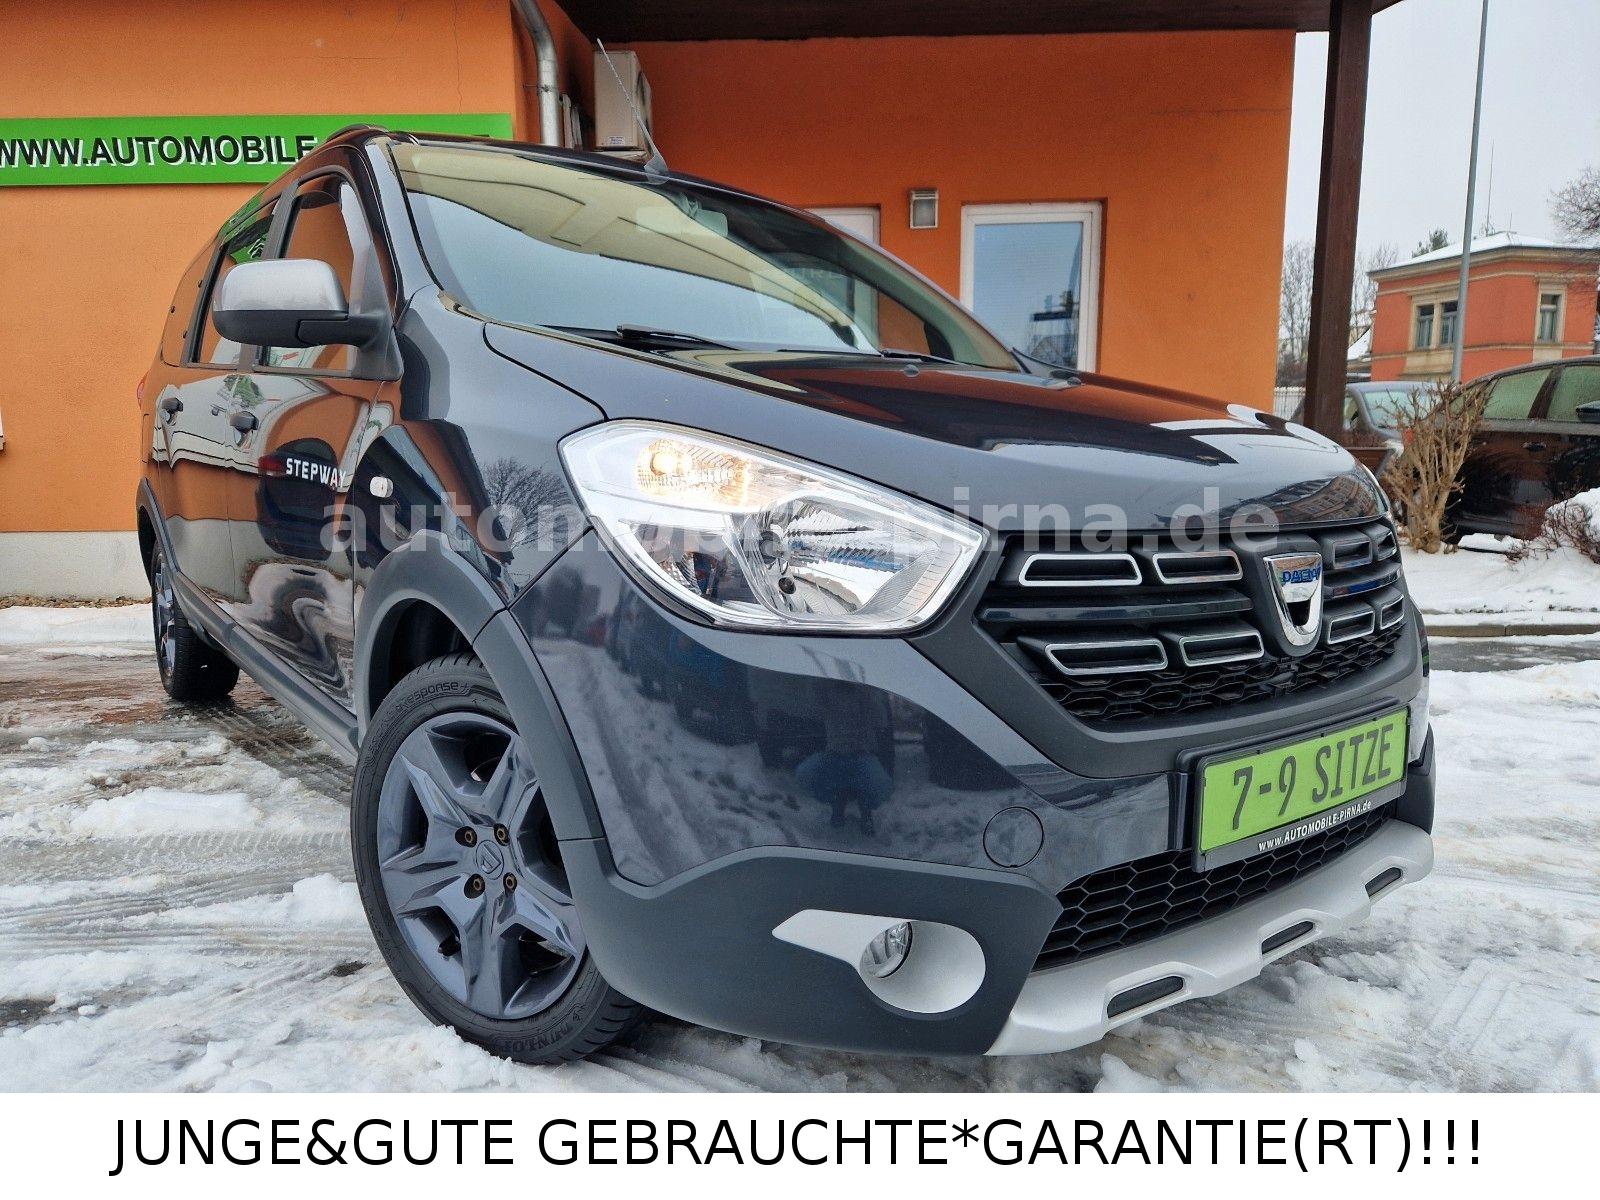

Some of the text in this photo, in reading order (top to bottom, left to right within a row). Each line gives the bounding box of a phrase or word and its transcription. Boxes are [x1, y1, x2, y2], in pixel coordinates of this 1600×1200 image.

[286, 457, 346, 488] STEPWAY
[1232, 723, 1394, 831] 7-9 SITZE
[1258, 800, 1372, 852] www.AUTOMOBILE-PIRNA.de
